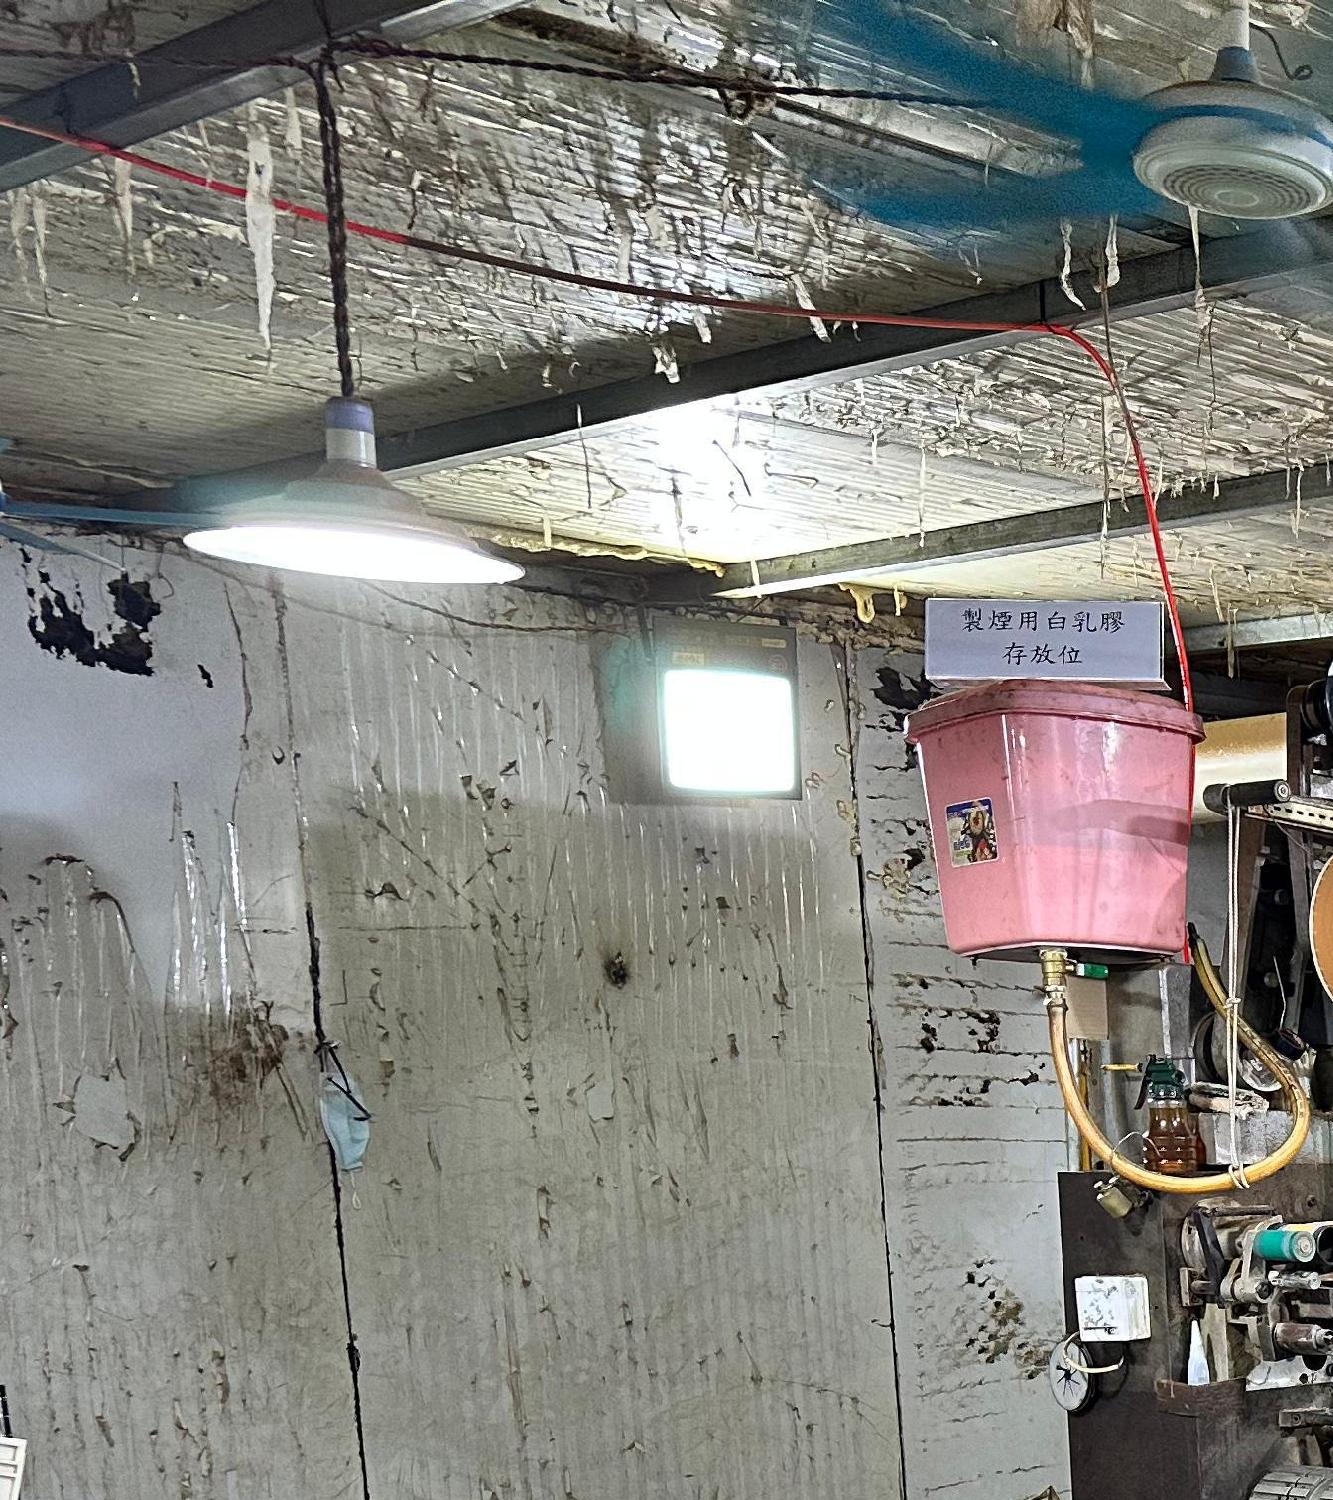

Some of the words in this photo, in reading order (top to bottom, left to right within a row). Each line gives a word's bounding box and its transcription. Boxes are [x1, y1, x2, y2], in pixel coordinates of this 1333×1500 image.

[961, 607, 1126, 634] 製煙用白乳膠
[1002, 641, 1083, 665] 存放位
